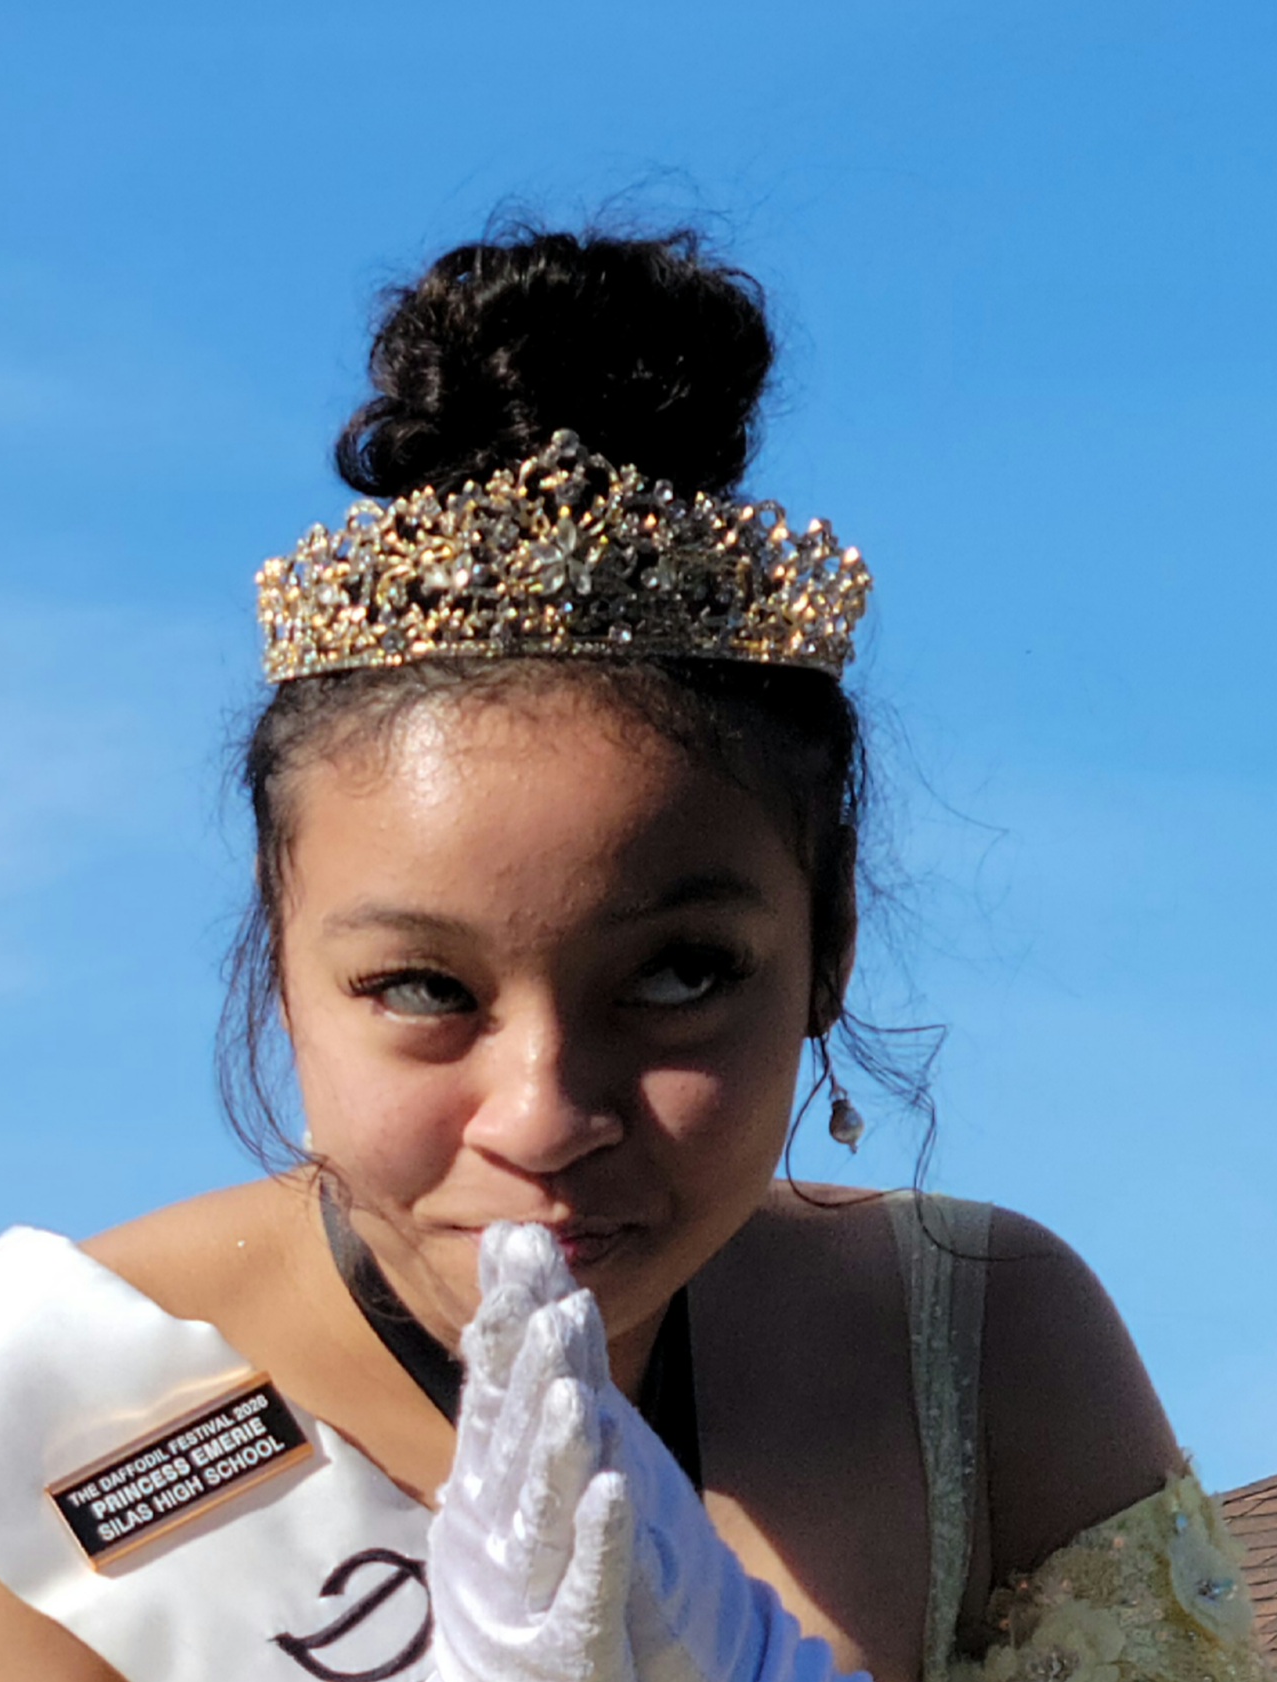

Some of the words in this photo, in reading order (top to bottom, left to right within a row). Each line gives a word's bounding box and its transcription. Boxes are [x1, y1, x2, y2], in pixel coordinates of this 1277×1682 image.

[69, 1486, 100, 1508] THE
[101, 1452, 170, 1490] DAFFODIL
[170, 1414, 234, 1455] FESTIVAL
[91, 1458, 191, 1519] PRINCESS
[194, 1417, 267, 1465] EMERIE
[98, 1503, 154, 1541] SILAS
[155, 1476, 205, 1512] HIGH
[204, 1436, 285, 1486] SCHOOL
